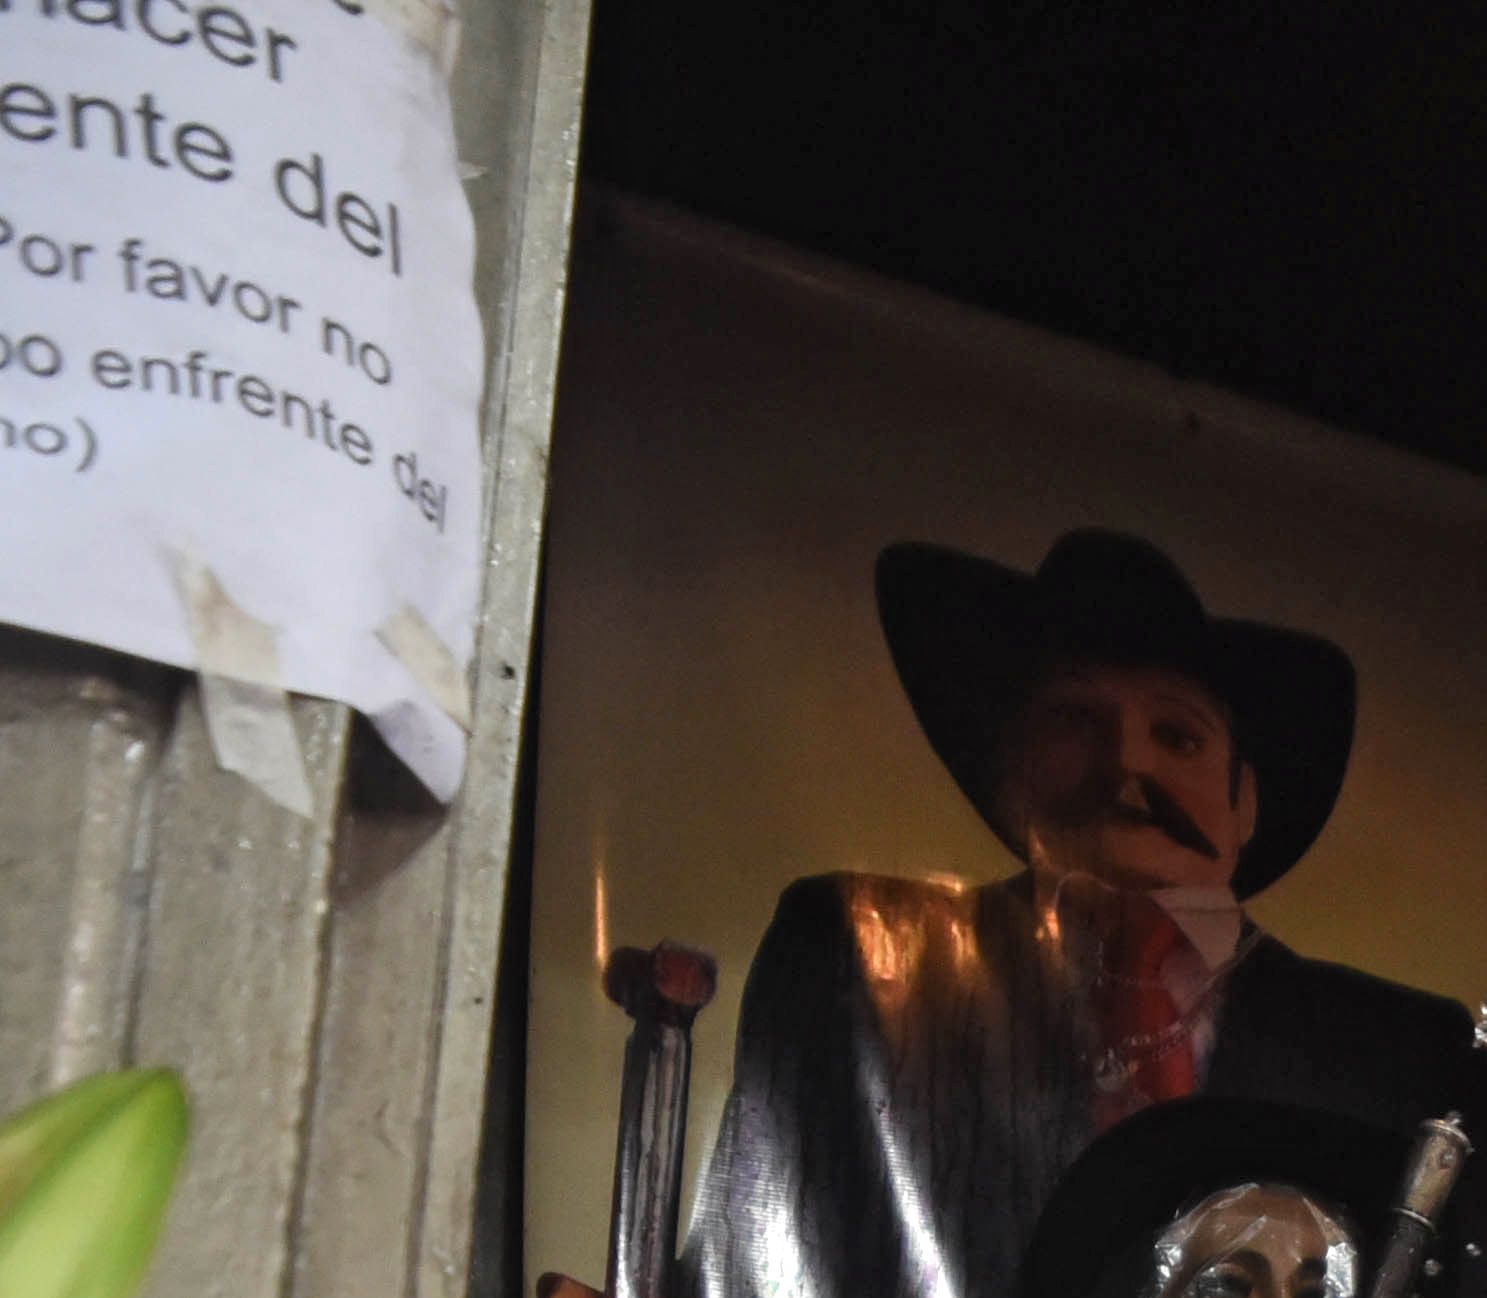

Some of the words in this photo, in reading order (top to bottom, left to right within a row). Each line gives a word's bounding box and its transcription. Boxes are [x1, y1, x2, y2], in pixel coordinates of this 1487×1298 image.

[273, 154, 405, 278] del
[119, 236, 301, 333] favor
[322, 319, 394, 386] no
[90, 349, 375, 467] enfrente
[392, 452, 449, 534] del
